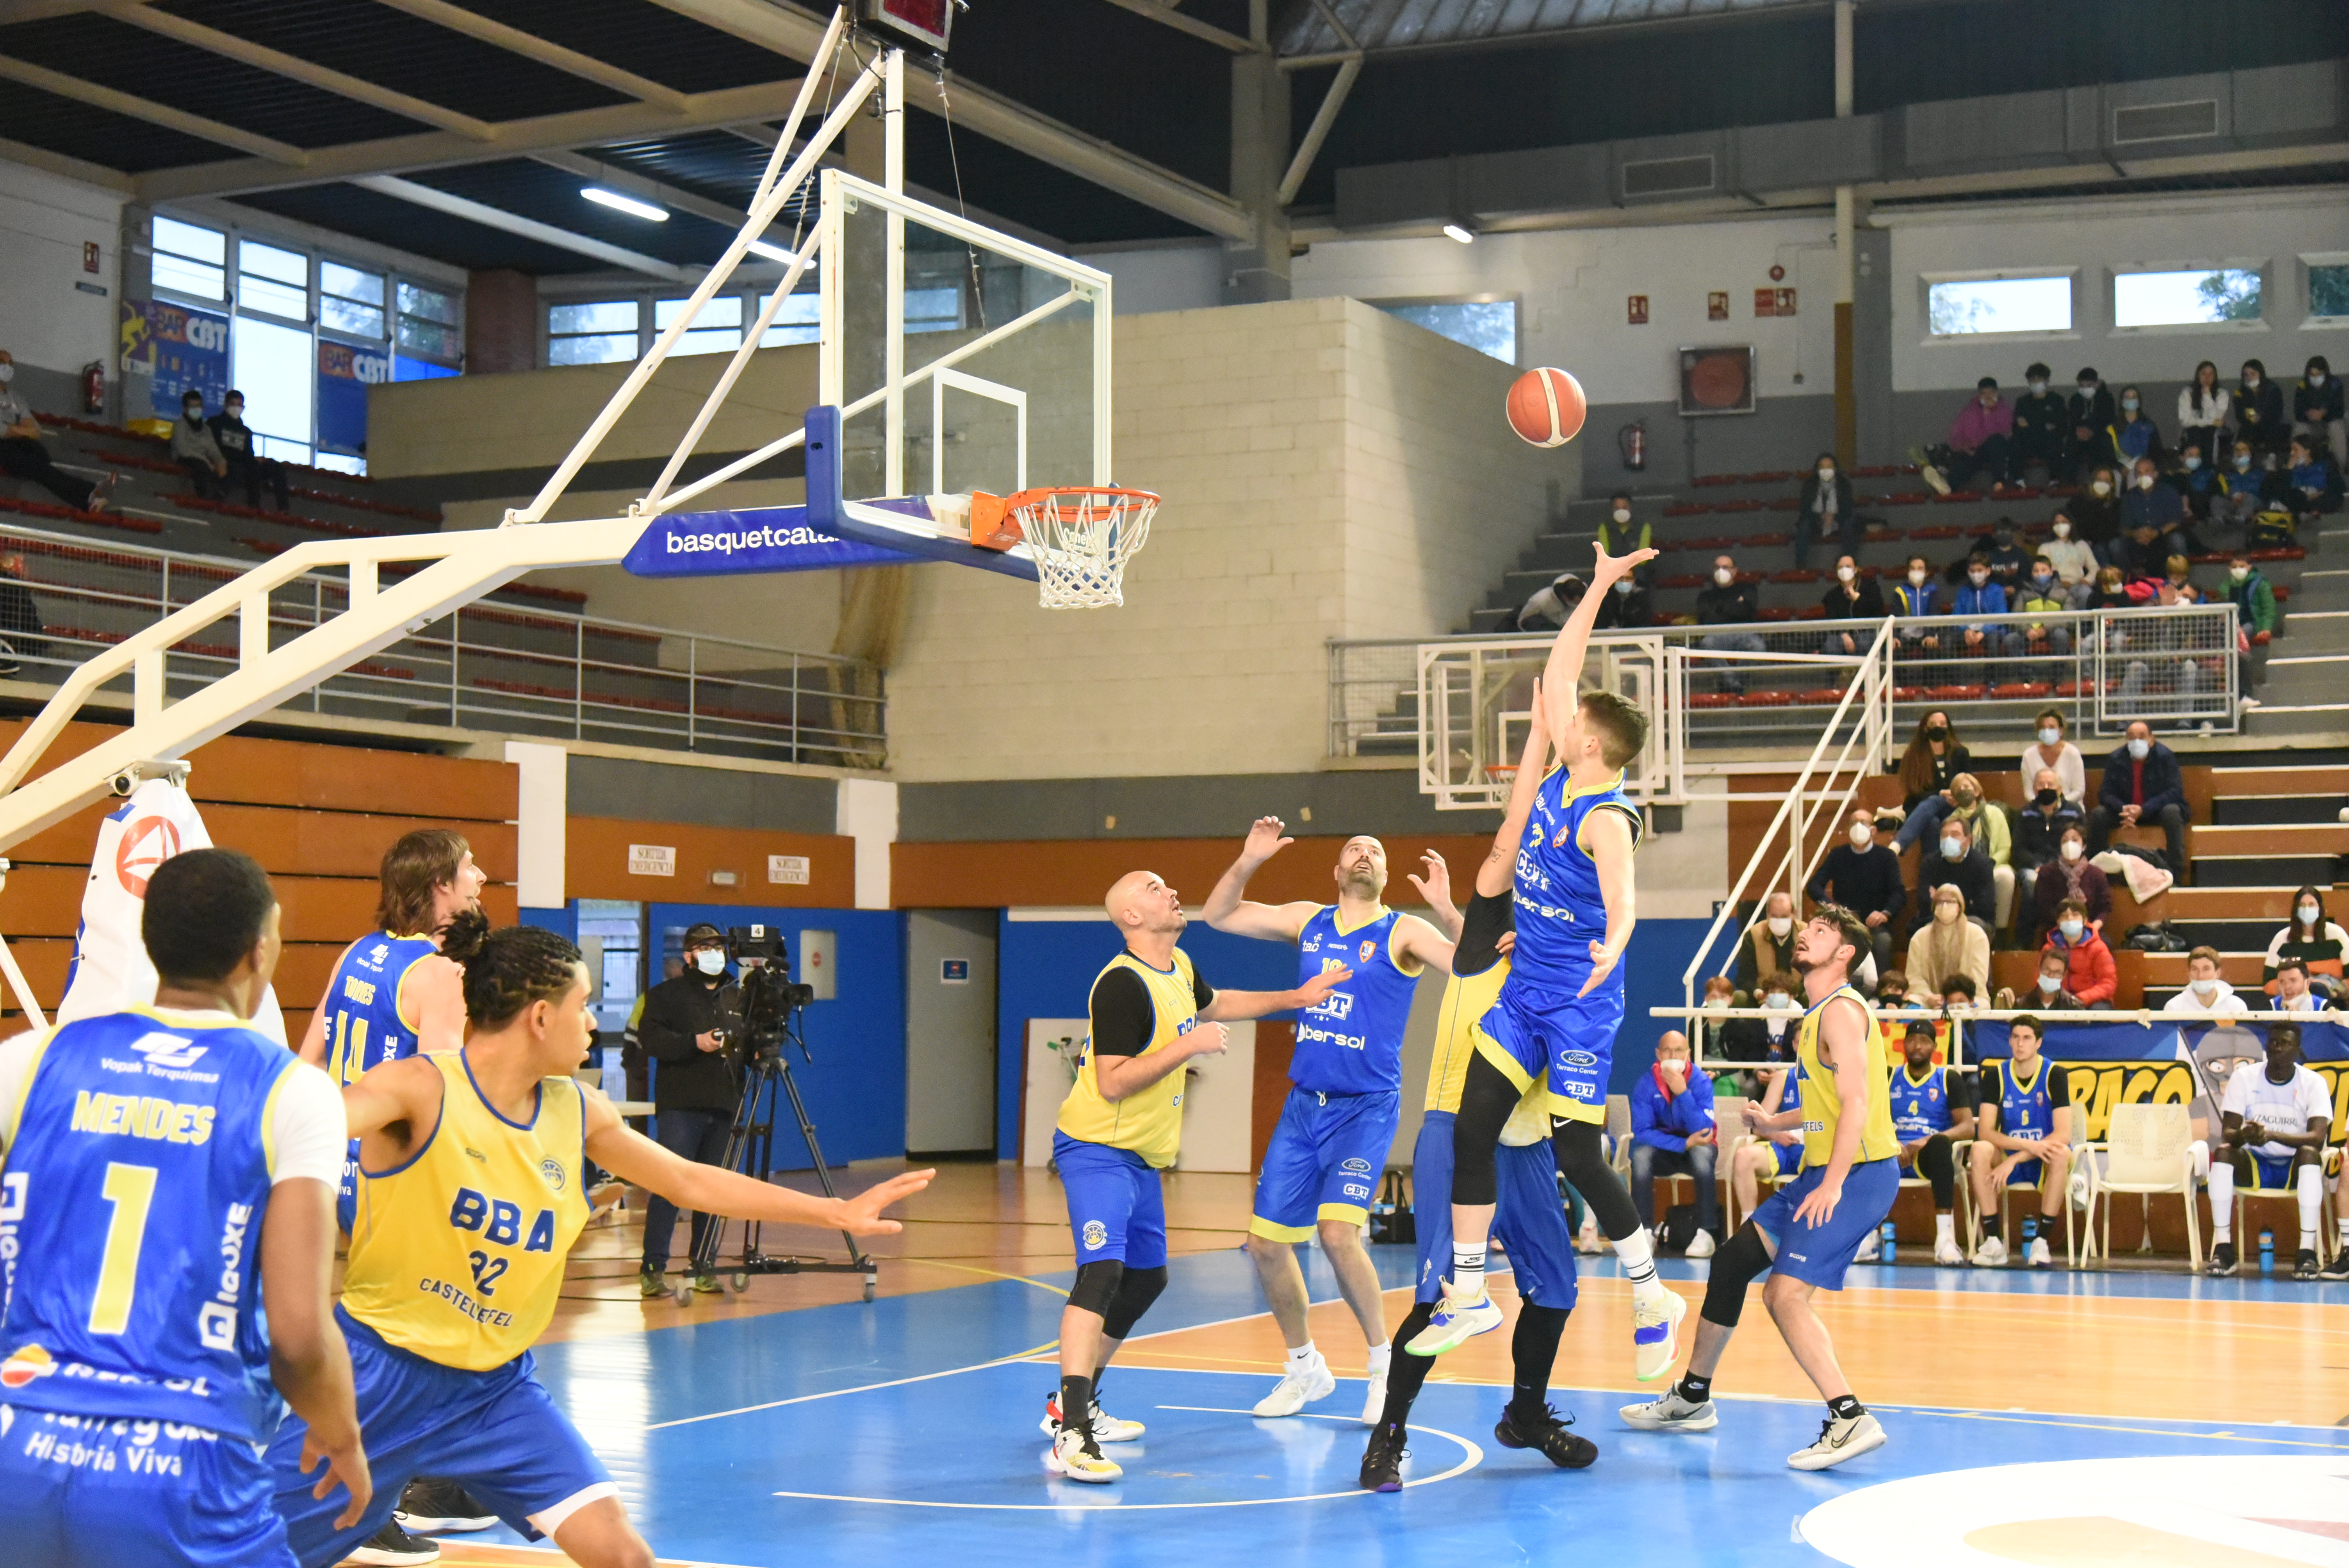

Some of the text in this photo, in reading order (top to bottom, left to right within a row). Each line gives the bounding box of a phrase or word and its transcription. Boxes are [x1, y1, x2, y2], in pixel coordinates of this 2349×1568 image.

[186, 317, 228, 353] CBT
[353, 354, 387, 383] CBT
[1302, 940, 1320, 952] tac
[1305, 991, 1353, 1019] BT
[102, 1058, 143, 1073] Vopak
[1568, 1053, 1589, 1063] Ford
[1556, 1063, 1578, 1072] Tarraco
[1565, 1082, 1594, 1096] CBT
[1908, 1100, 1918, 1116] 4
[70, 1090, 216, 1146] MENDES
[2021, 1109, 2029, 1126] 6
[1348, 1160, 1366, 1169] Ford
[1358, 1172, 1372, 1180] Center
[1344, 1184, 1369, 1199] CBT
[449, 1186, 554, 1253] BBA
[87, 1162, 158, 1335] 1
[469, 1250, 508, 1297] 32
[127, 1446, 182, 1477] Viva
